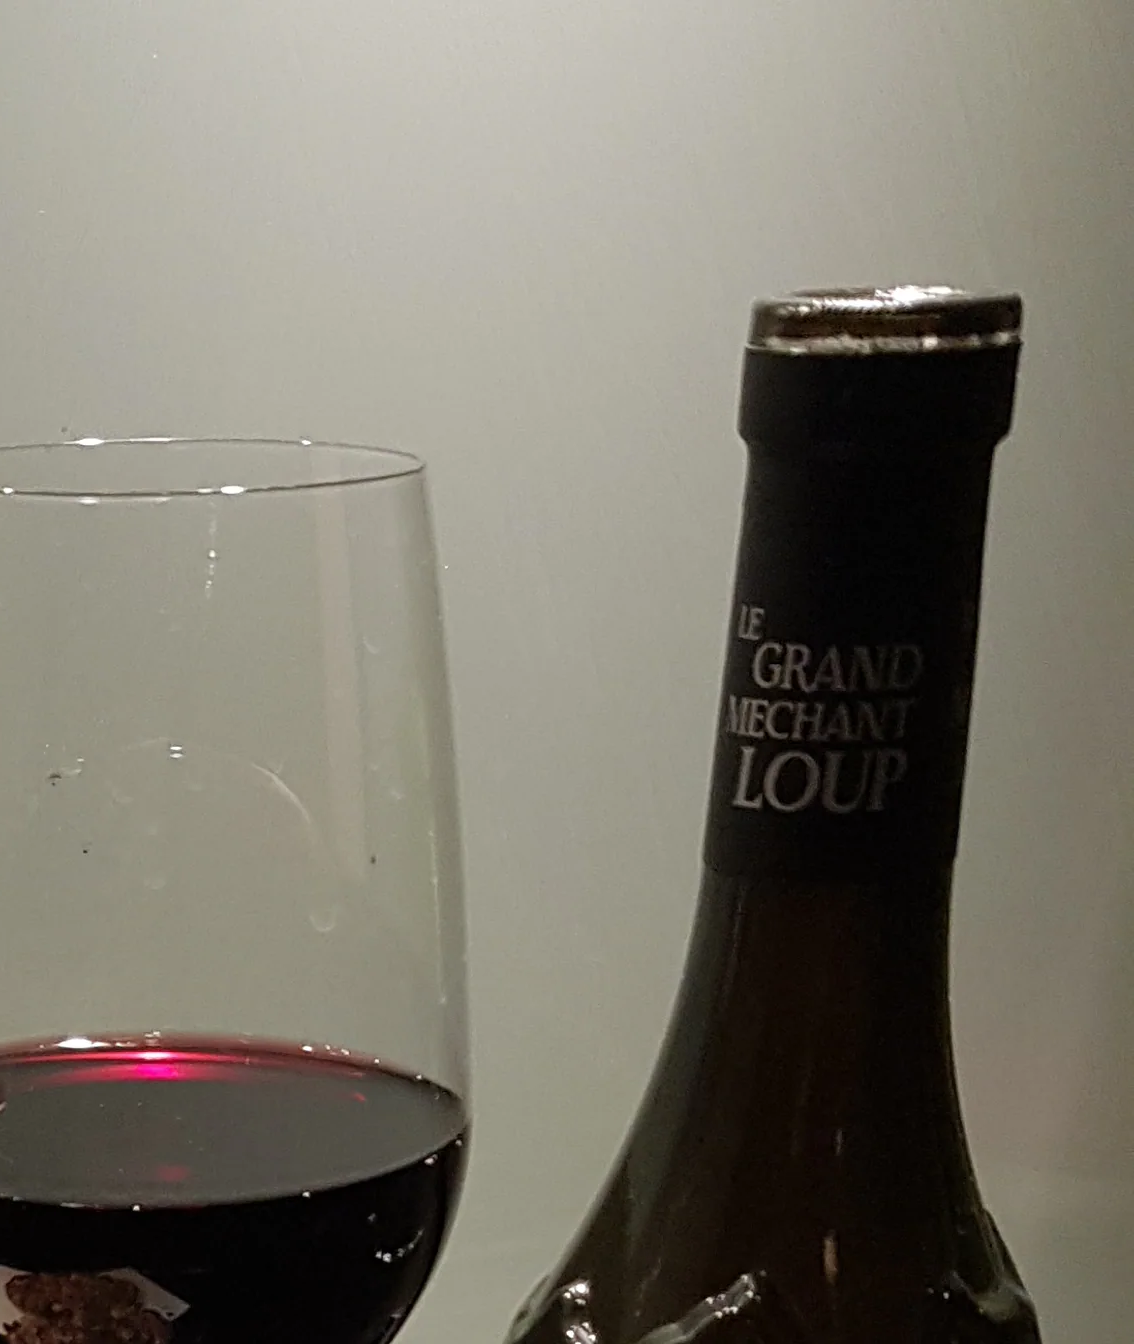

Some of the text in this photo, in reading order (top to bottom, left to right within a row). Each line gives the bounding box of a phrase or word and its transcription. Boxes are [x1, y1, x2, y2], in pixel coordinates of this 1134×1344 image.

[737, 604, 765, 641] LE
[752, 641, 923, 693] GRAND
[726, 694, 915, 741] MECHANT
[731, 745, 908, 814] LOUP
